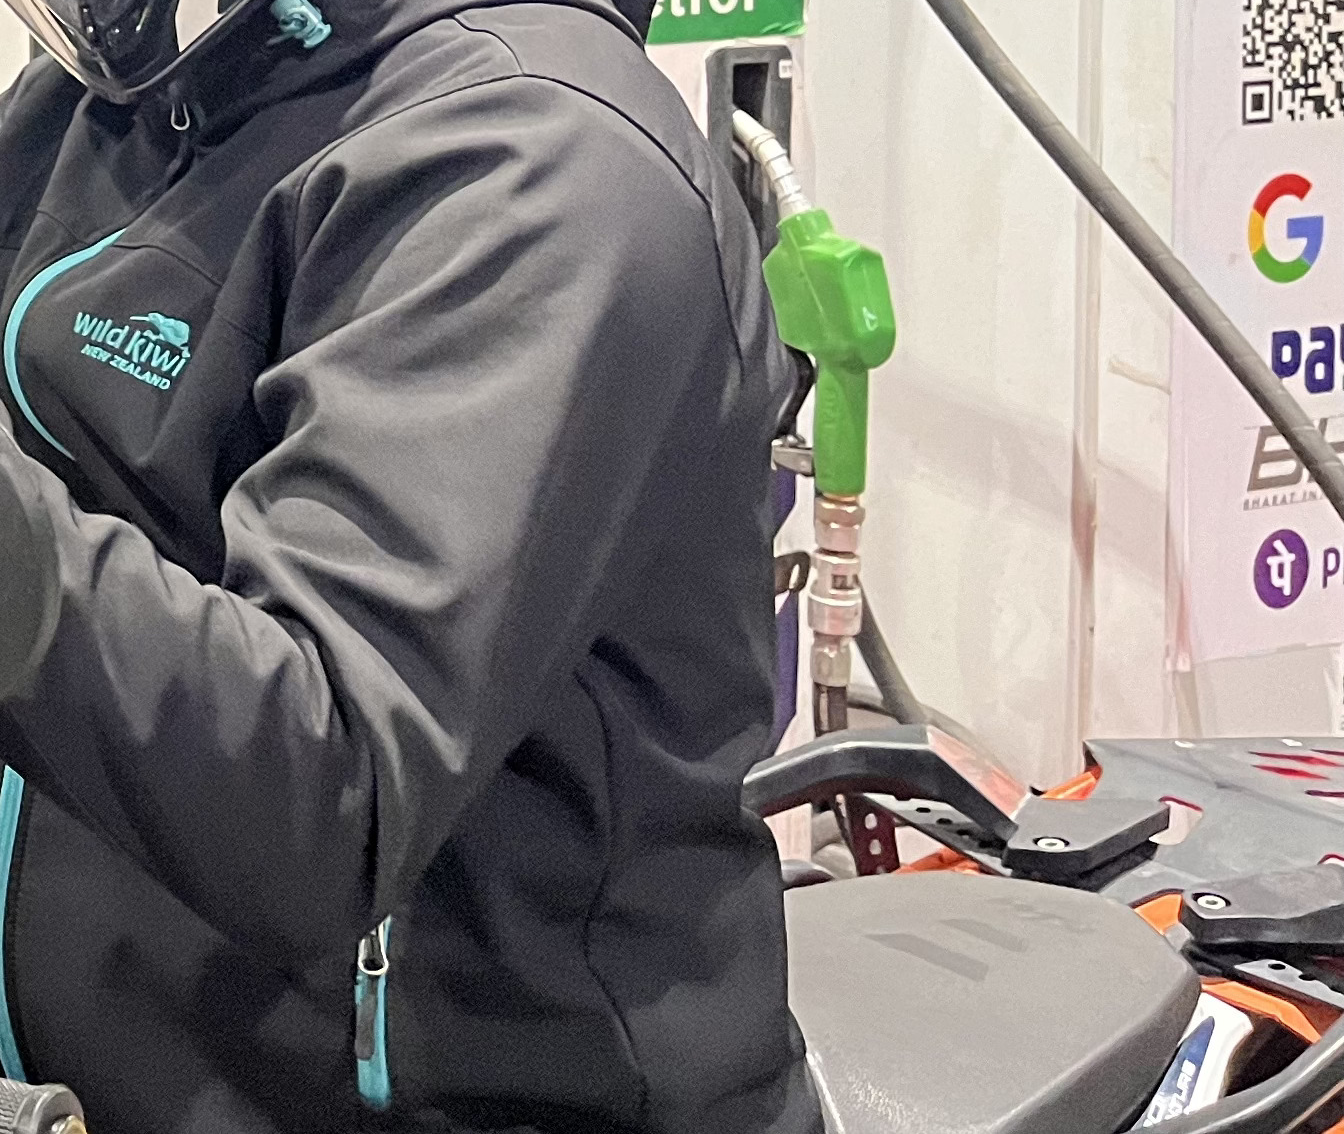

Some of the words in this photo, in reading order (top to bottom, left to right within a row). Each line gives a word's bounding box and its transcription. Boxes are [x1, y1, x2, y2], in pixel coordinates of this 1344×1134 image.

[1247, 173, 1325, 284] G
[81, 343, 112, 363] NEW
[109, 354, 171, 390] ZEALAND
